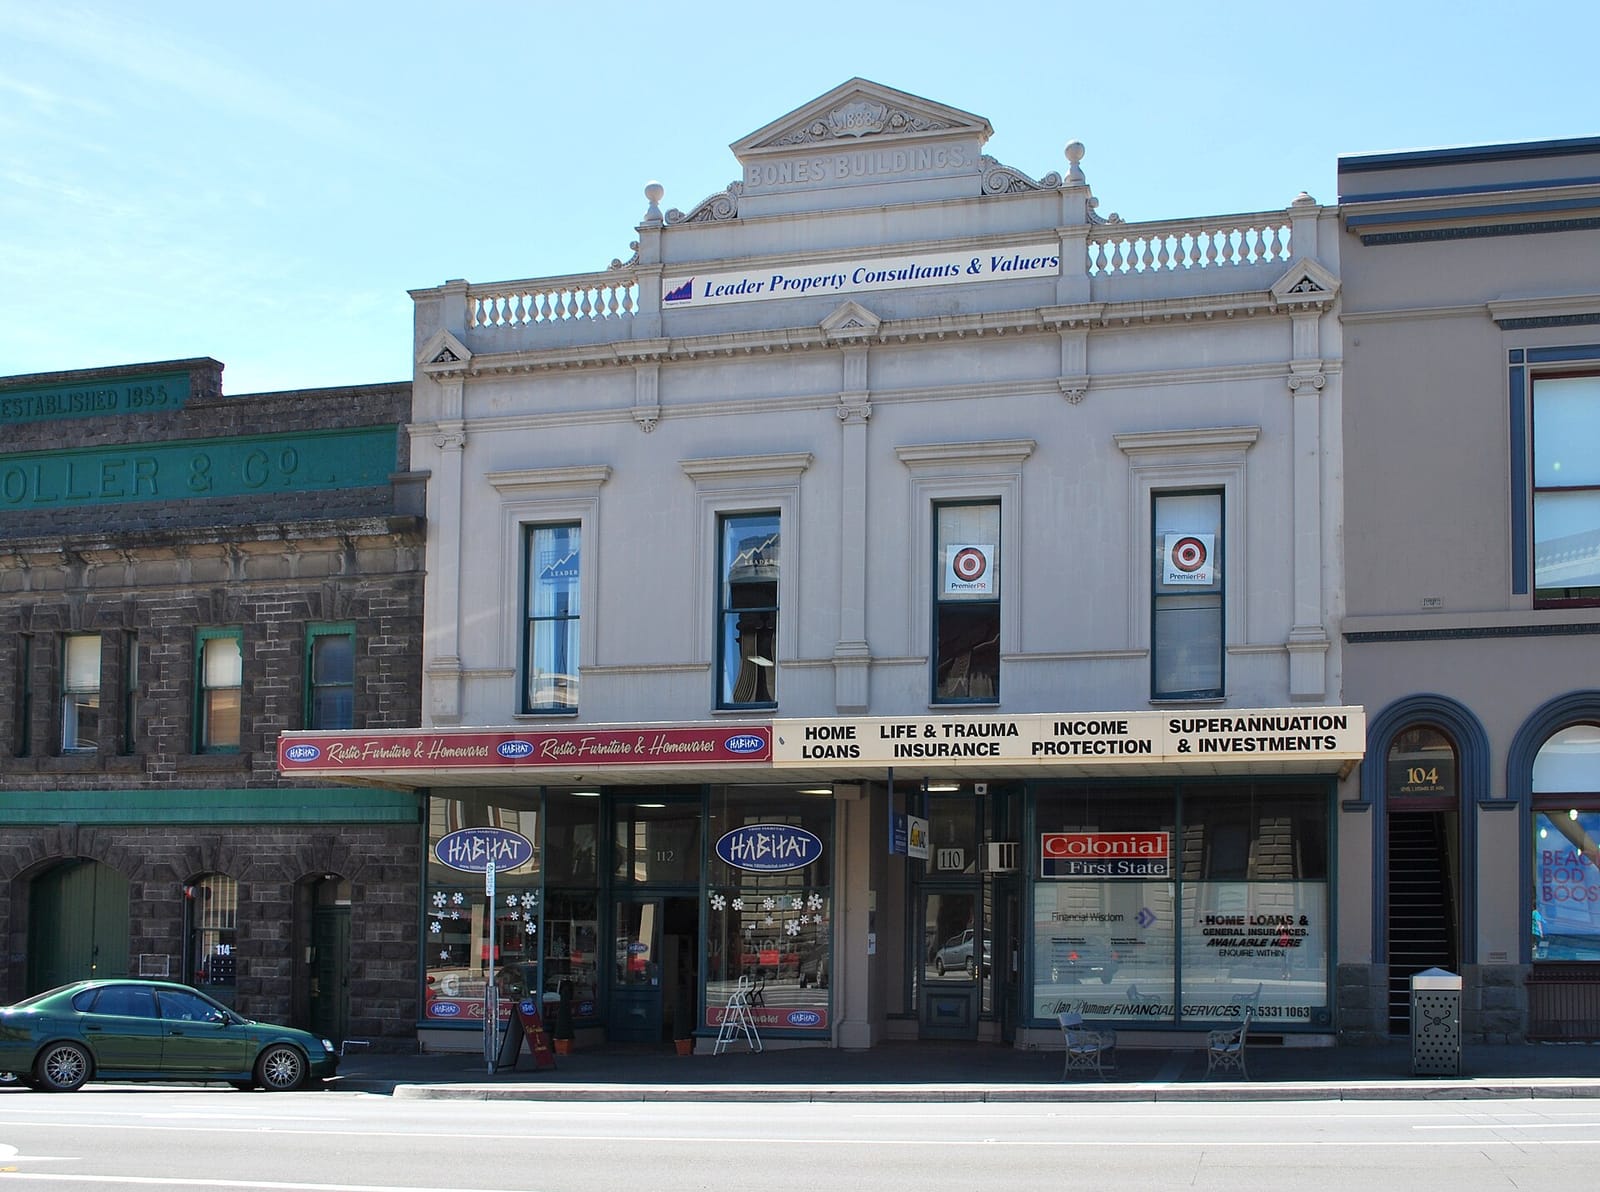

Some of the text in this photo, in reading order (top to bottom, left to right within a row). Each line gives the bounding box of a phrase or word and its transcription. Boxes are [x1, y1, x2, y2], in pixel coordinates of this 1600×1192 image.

[704, 255, 1060, 298] Leader Property Consultants & Valuers
[2, 389, 118, 418] ESTABLISHED
[187, 453, 213, 492] &
[879, 722, 1019, 739] LIFE & TRAUMA
[1053, 720, 1128, 736] INCOME
[1168, 715, 1348, 734] SUPERANNUATION
[805, 726, 856, 740] HOME
[326, 743, 361, 764] Rustic
[362, 741, 411, 761] Furniture
[413, 741, 423, 759] &
[427, 739, 489, 760] Homewares
[539, 738, 577, 760] Rustic
[578, 736, 632, 757] Furniture
[634, 736, 645, 755] &
[648, 734, 716, 756] Homewares
[802, 744, 860, 759] LOANS
[894, 742, 1000, 758] INSURANCE
[1031, 739, 1152, 756] PROTECTION
[1177, 735, 1337, 753] & INVESTMENTS
[1407, 767, 1439, 784] 104
[1045, 836, 1164, 855] Colonial
[656, 850, 674, 862] 112
[940, 850, 961, 868] 110
[1542, 850, 1600, 867] BEAC
[1068, 861, 1165, 874] First State
[1542, 868, 1585, 884] BOD
[1051, 911, 1124, 921] Financial Wisdom
[1205, 915, 1309, 926] HOME LOANS &
[1202, 928, 1245, 936] GENERAL
[215, 944, 230, 956] 114
[1206, 938, 1303, 947] AVAILABLE HERE
[1218, 949, 1254, 957] ENQUIRE
[1112, 1003, 1175, 1016] FINANCIAL
[1258, 1006, 1282, 1017] 5331
[1286, 1006, 1310, 1018] 1063
